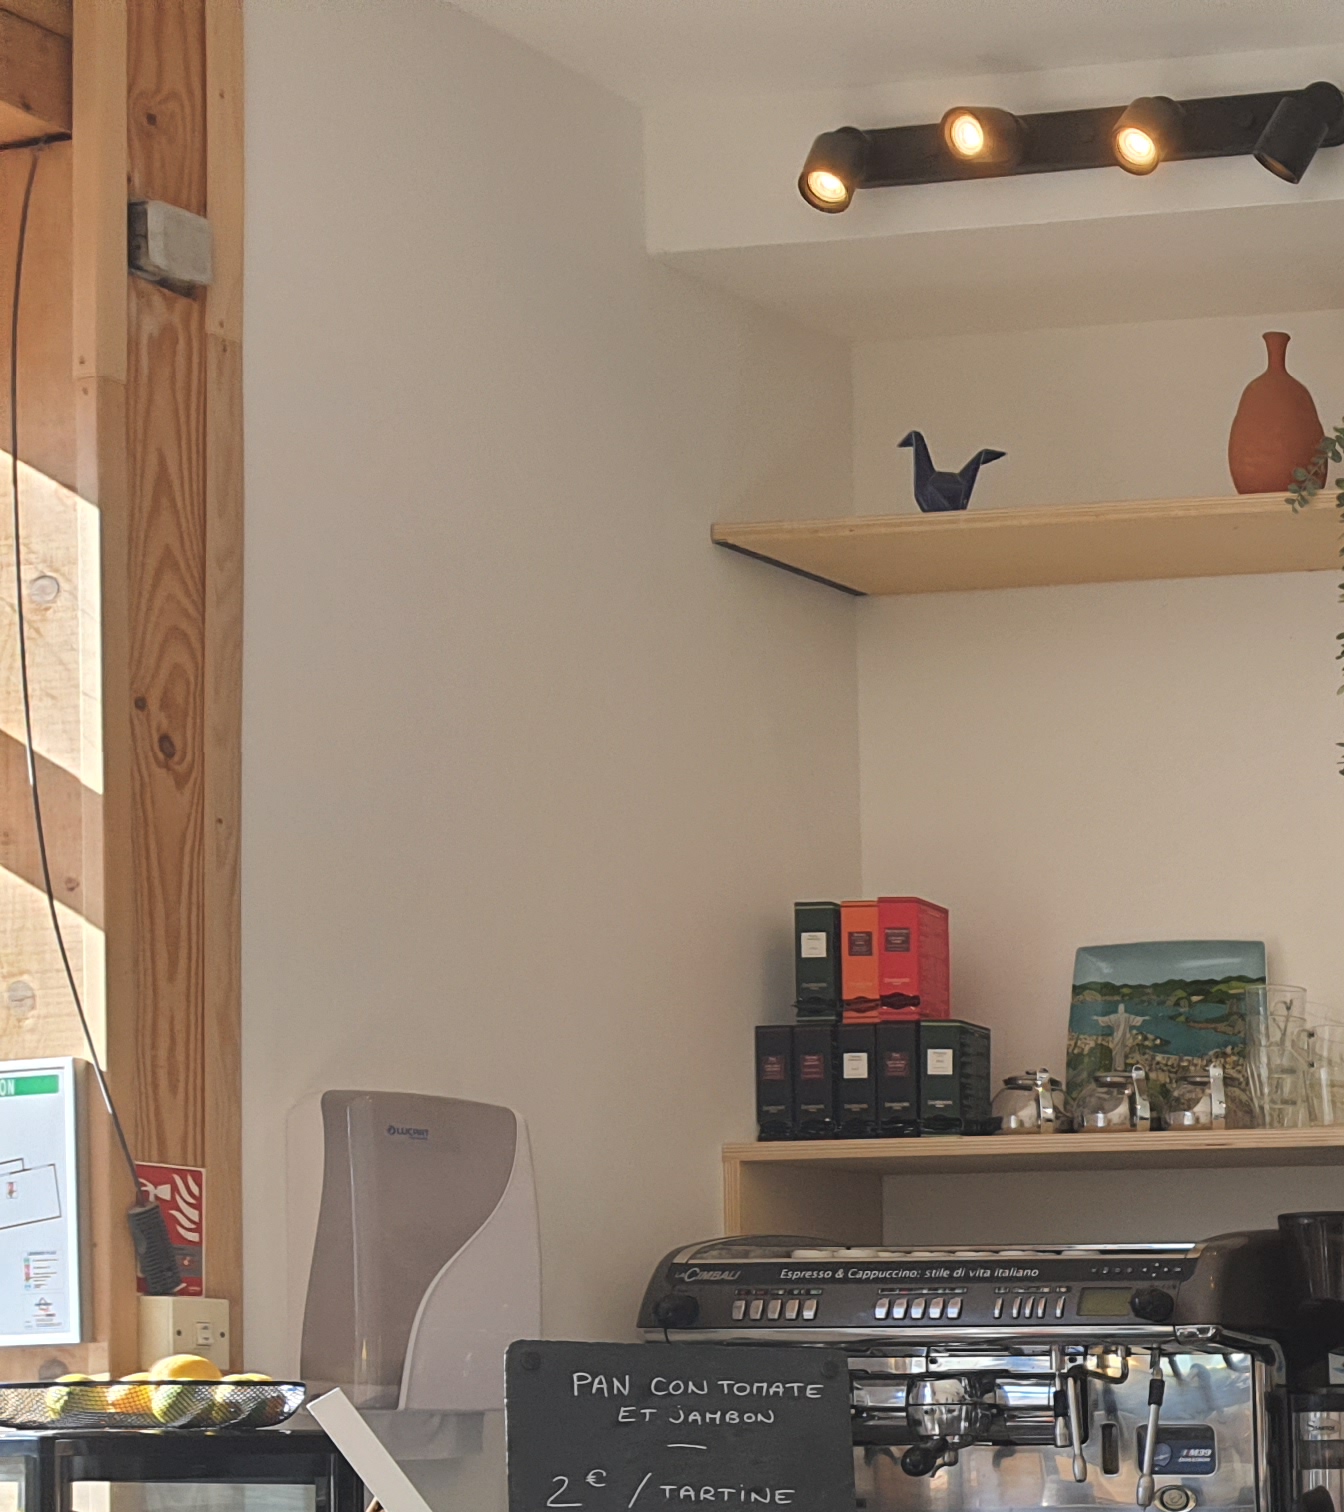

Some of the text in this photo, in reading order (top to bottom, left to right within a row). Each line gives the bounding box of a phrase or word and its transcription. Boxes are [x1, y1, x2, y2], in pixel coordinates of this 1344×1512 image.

[780, 1268, 832, 1281] Espresso
[848, 1267, 922, 1281] Cappuccino:
[924, 1267, 950, 1279] stile
[968, 1266, 991, 1278] vita
[994, 1266, 1040, 1278] italiano
[572, 1372, 824, 1400] PAN CON TOMATE
[617, 1406, 657, 1423] ET
